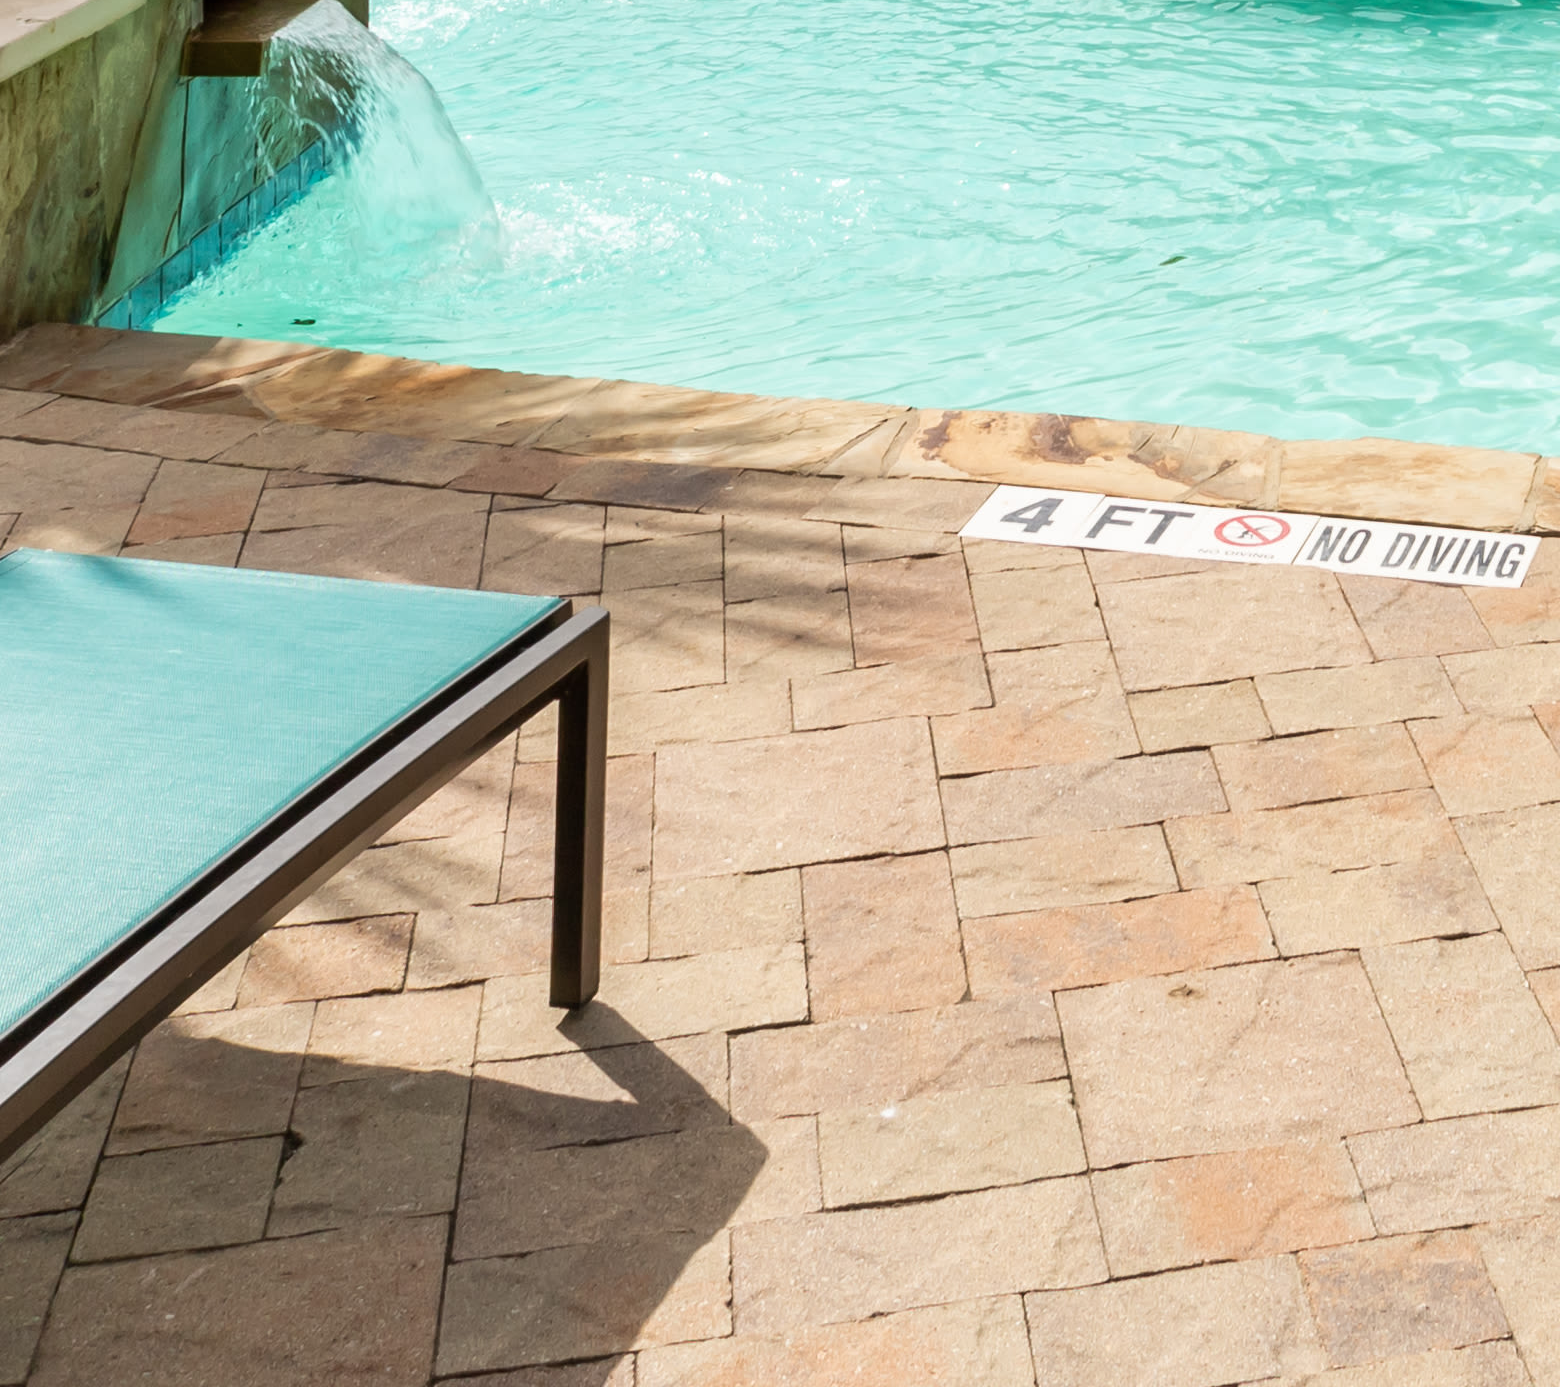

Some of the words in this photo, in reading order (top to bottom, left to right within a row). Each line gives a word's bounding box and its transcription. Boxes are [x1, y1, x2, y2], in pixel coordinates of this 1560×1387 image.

[999, 497, 1065, 534] 4
[1085, 504, 1196, 545] FT
[1306, 525, 1372, 564] NO
[1380, 532, 1526, 579] DIVING
